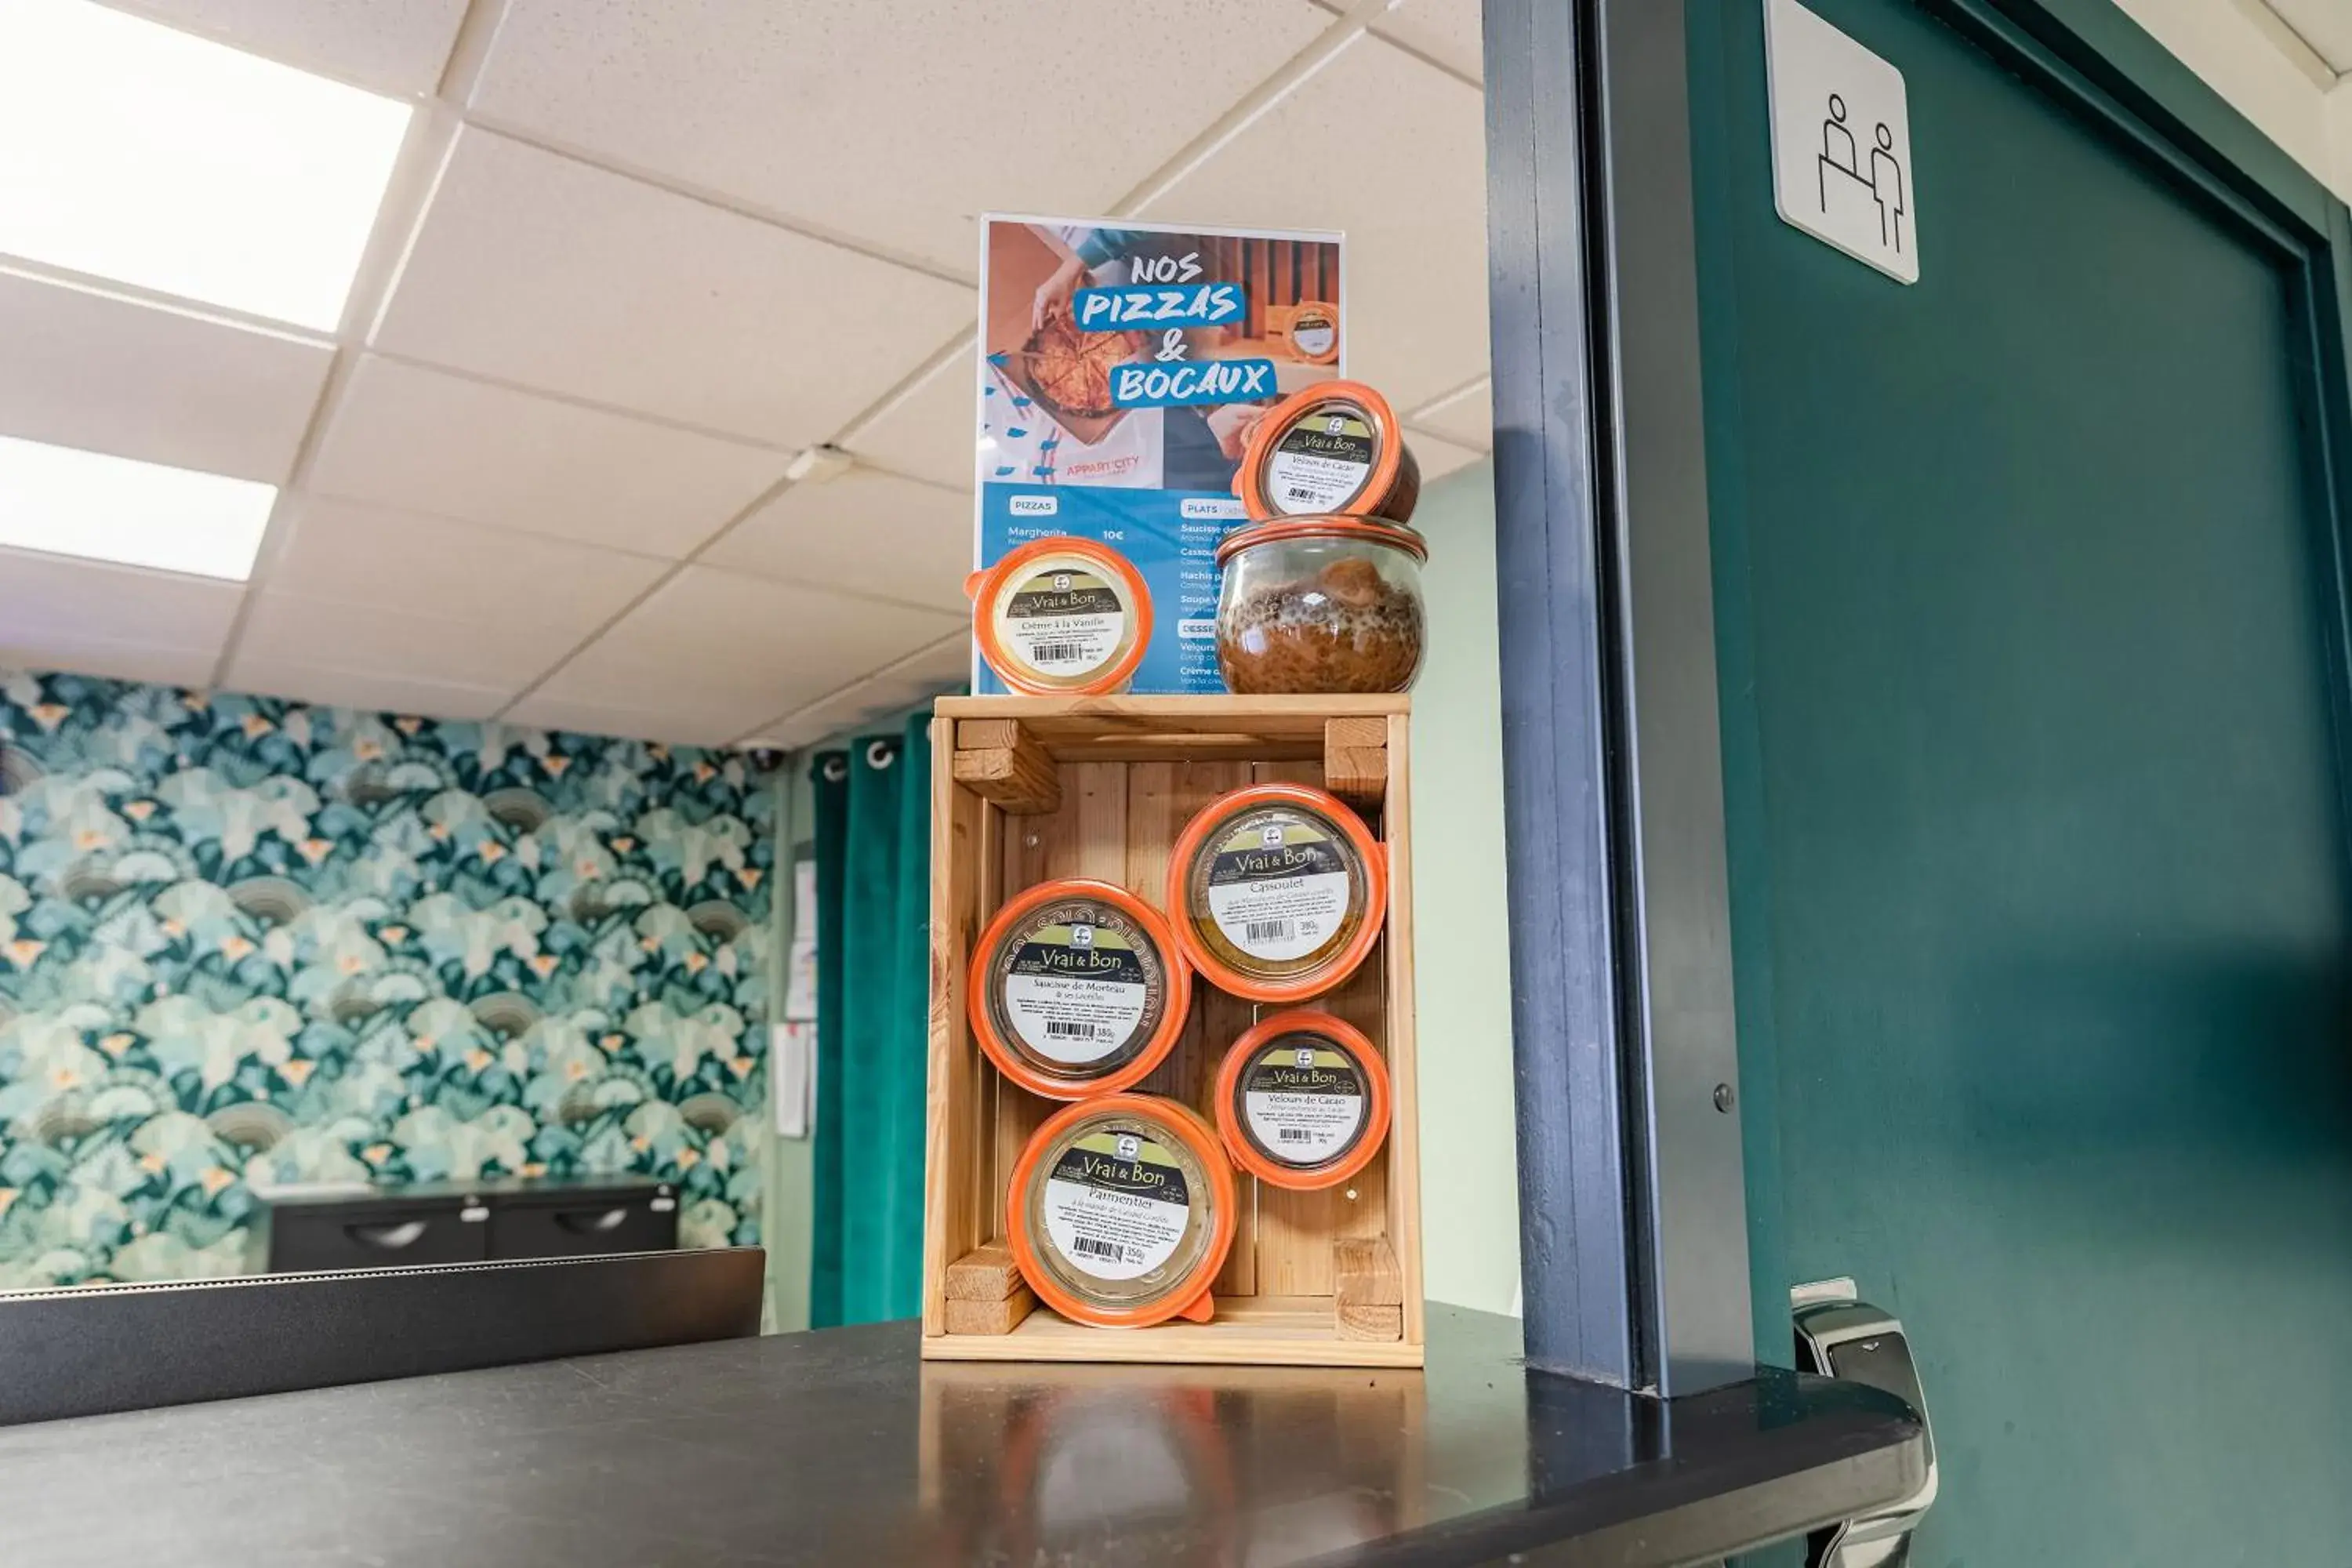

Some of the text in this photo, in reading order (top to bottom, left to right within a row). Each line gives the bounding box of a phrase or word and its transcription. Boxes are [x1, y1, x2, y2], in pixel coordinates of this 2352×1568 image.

[1131, 251, 1203, 284] NOS
[1082, 285, 1237, 325] PIZZAS
[1154, 328, 1188, 362] &
[1118, 361, 1269, 401] BOCAUX
[1304, 435, 1325, 448] Vrai
[1333, 437, 1356, 450] Bon
[1015, 501, 1052, 510] PIZZAS
[1188, 504, 1218, 514] PLATS
[1103, 530, 1123, 540] 10€
[1033, 596, 1058, 608] Vrai
[1070, 592, 1095, 604] Bon
[1236, 847, 1316, 873] Vrai & Bon
[1250, 878, 1304, 894] Cassoulet
[1041, 949, 1074, 968] Vrai
[1076, 956, 1086, 965] &
[1090, 951, 1122, 968] Bon
[1033, 978, 1125, 994] Saucisse de Morteau
[1274, 1070, 1299, 1083] Vrai
[1312, 1071, 1337, 1083] Bon
[1269, 1094, 1346, 1105] Velours de Cacao
[1084, 1156, 1116, 1178] Vrai
[1119, 1168, 1128, 1179] &
[1132, 1164, 1165, 1186] Bon
[1089, 1187, 1154, 1210] Parmentier
